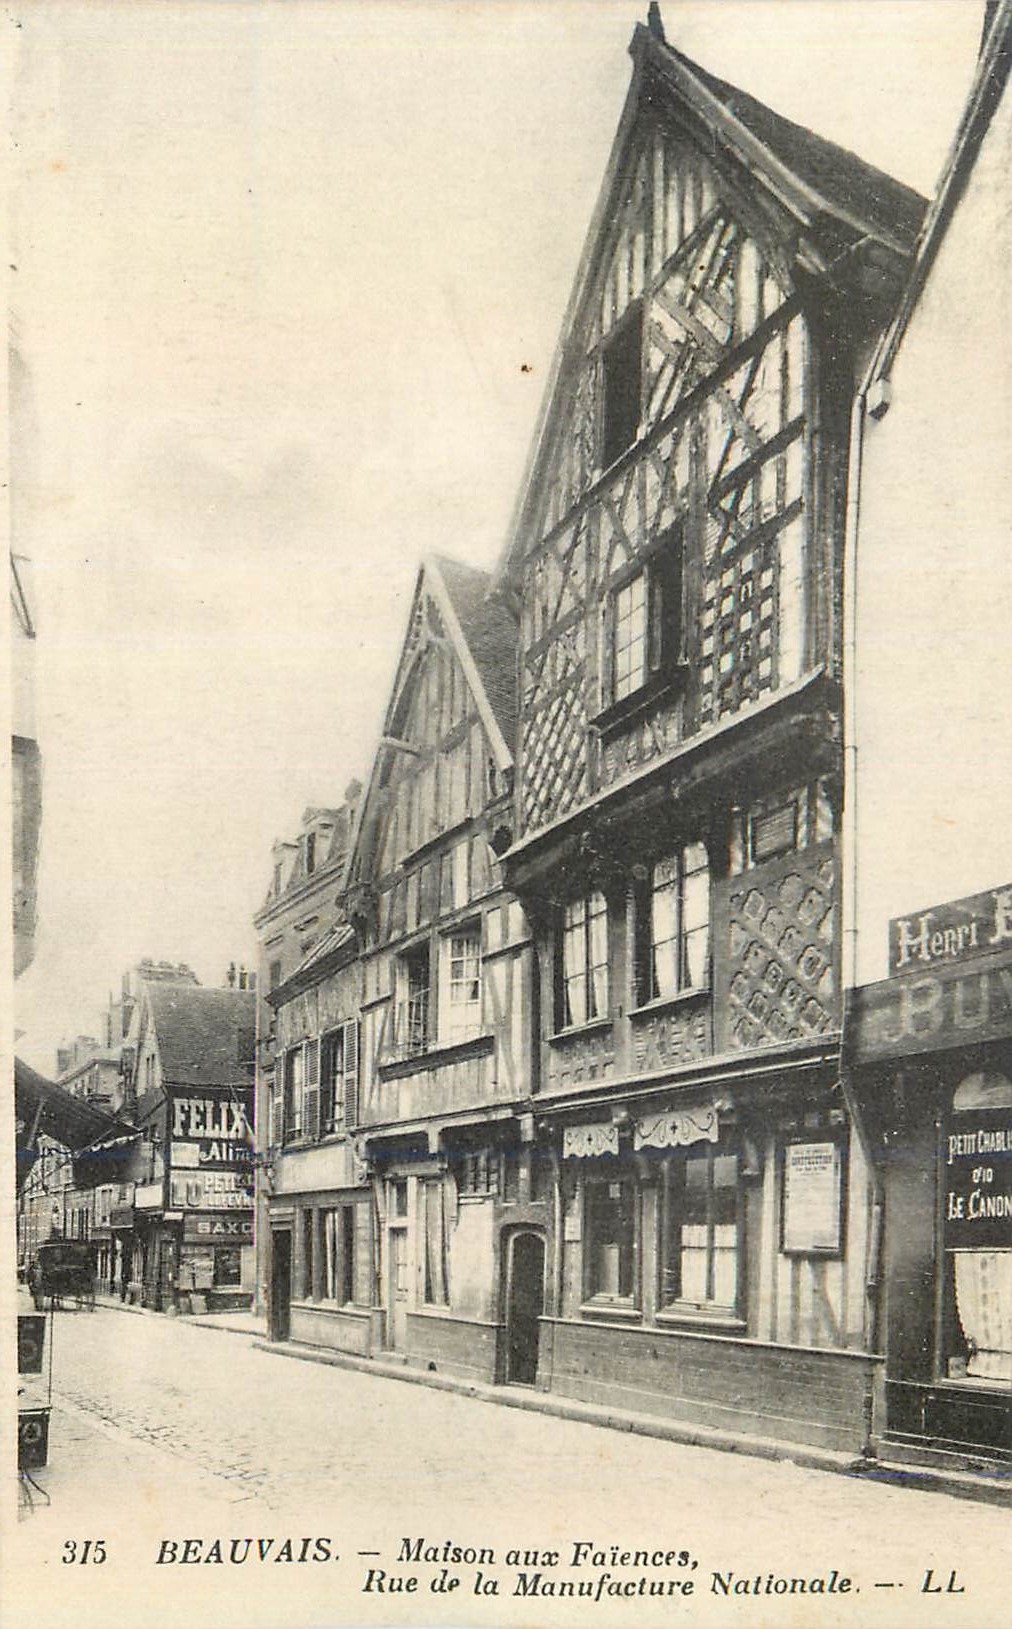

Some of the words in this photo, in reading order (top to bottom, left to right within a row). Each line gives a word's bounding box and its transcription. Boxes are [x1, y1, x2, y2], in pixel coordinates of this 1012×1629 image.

[896, 912, 978, 967] Henri
[947, 1132, 977, 1165] PETIT
[947, 1191, 964, 1220] LE
